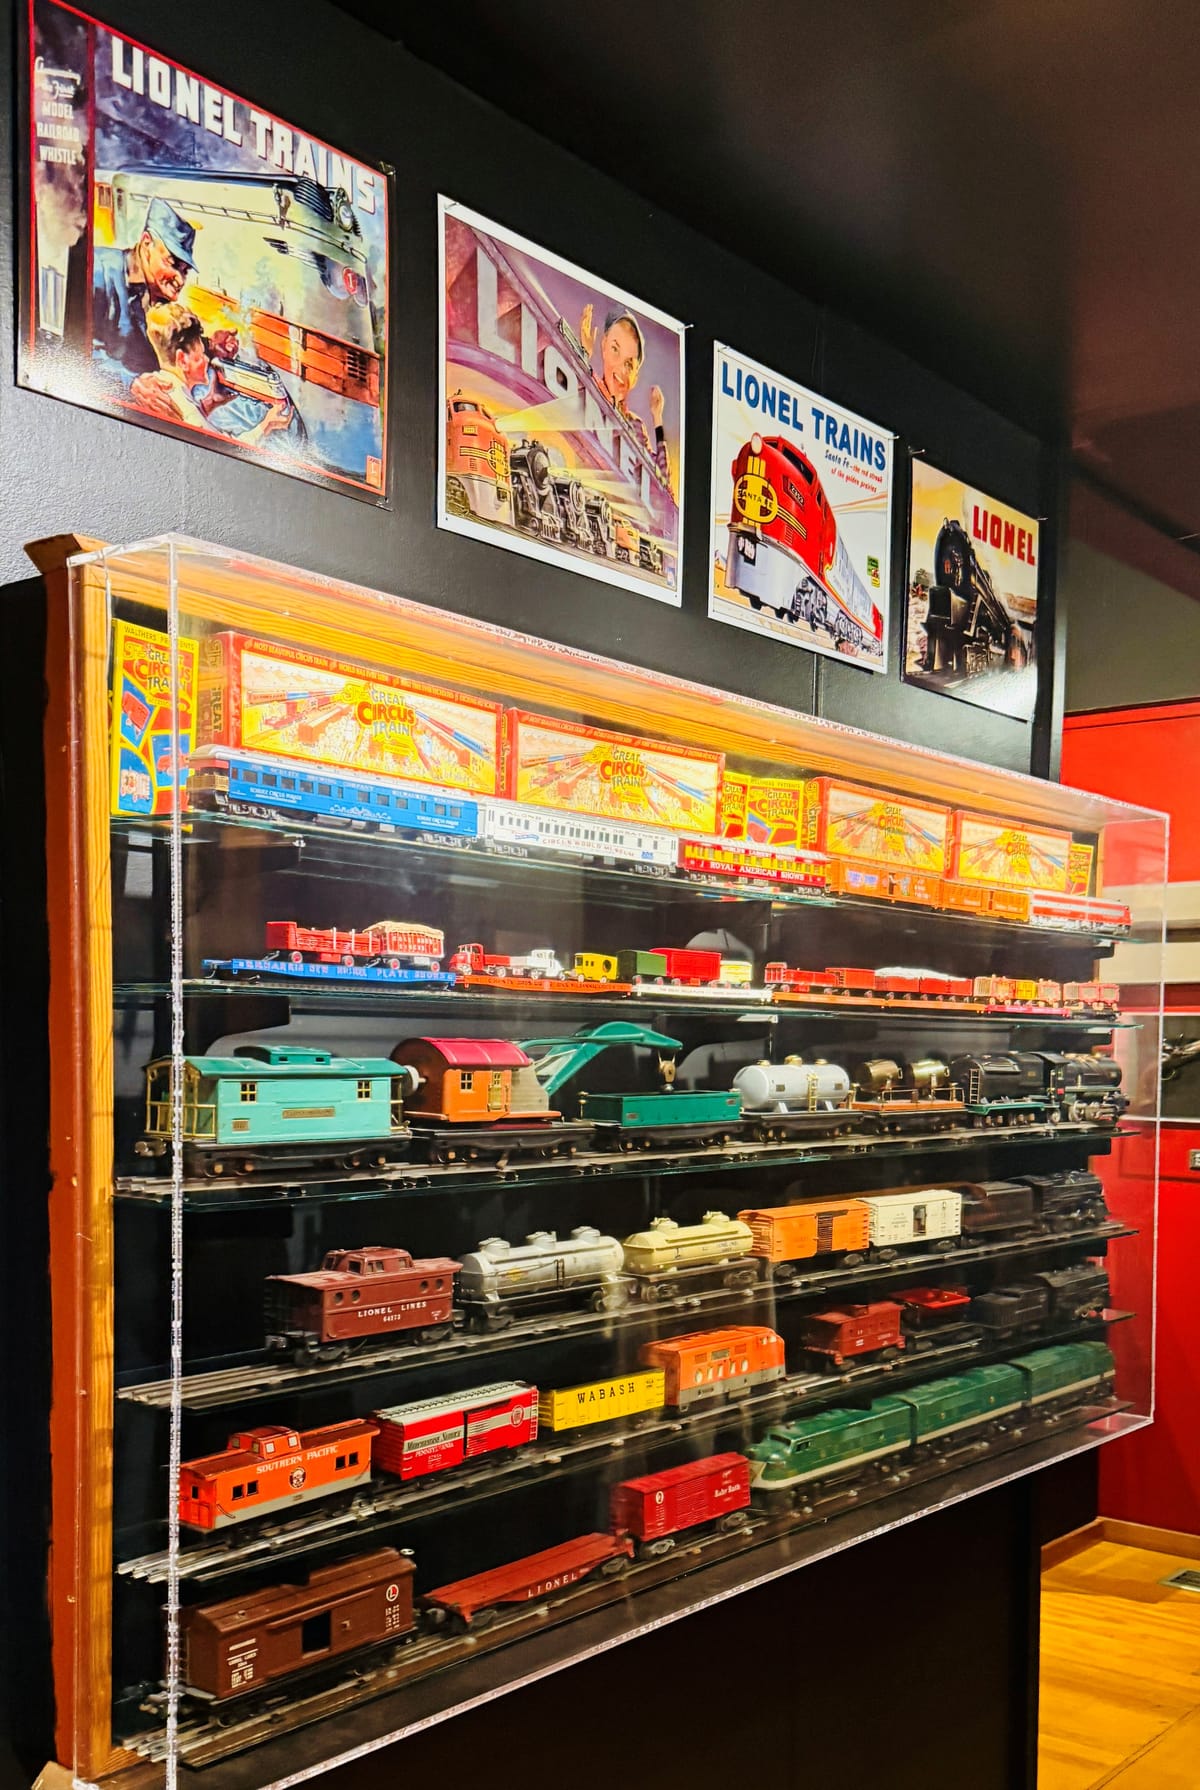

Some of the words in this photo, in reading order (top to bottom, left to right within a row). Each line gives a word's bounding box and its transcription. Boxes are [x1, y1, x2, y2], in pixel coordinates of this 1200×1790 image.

[41, 102, 73, 120] MODEL
[36, 121, 80, 142] RAILROAD
[111, 36, 243, 147] LIONEL
[247, 111, 376, 215] TRAINS
[39, 144, 77, 165] WHISTLE
[722, 360, 803, 432] LIONEL
[811, 407, 886, 471] TRAINS
[738, 489, 761, 503] SANTA
[972, 505, 1035, 567] LIONEL
[124, 626, 157, 641] WALTHERS
[253, 640, 268, 651] MOST
[269, 643, 296, 659] BEAUTIFUL
[296, 650, 313, 663] CIRCUS
[313, 655, 328, 667] TRAIN
[371, 689, 405, 706] GREAT
[358, 702, 415, 725] CIRCUS
[373, 720, 410, 739] TRAIN
[613, 750, 641, 763] GREAT
[600, 760, 644, 780] CIRCUS
[612, 775, 641, 790] TRAIN
[768, 791, 792, 800] GREAT
[757, 799, 798, 814] CIRCUS
[768, 809, 794, 819] TRAIN
[542, 838, 571, 846] CIRCUS
[574, 841, 602, 850] WORLD
[710, 862, 736, 871] ROYAL
[739, 866, 777, 878] AMERICAN
[781, 871, 804, 881] SHOWS
[377, 969, 408, 979] PLATE
[358, 1307, 392, 1318] LIONEL
[401, 1301, 427, 1311] LINES
[577, 1382, 635, 1404] WABASH
[415, 1442, 455, 1457] PENNSYLVANIA
[256, 1456, 302, 1474] SOUTHERN
[306, 1445, 339, 1460] PACIFIC
[528, 1572, 577, 1599] LIONEL
